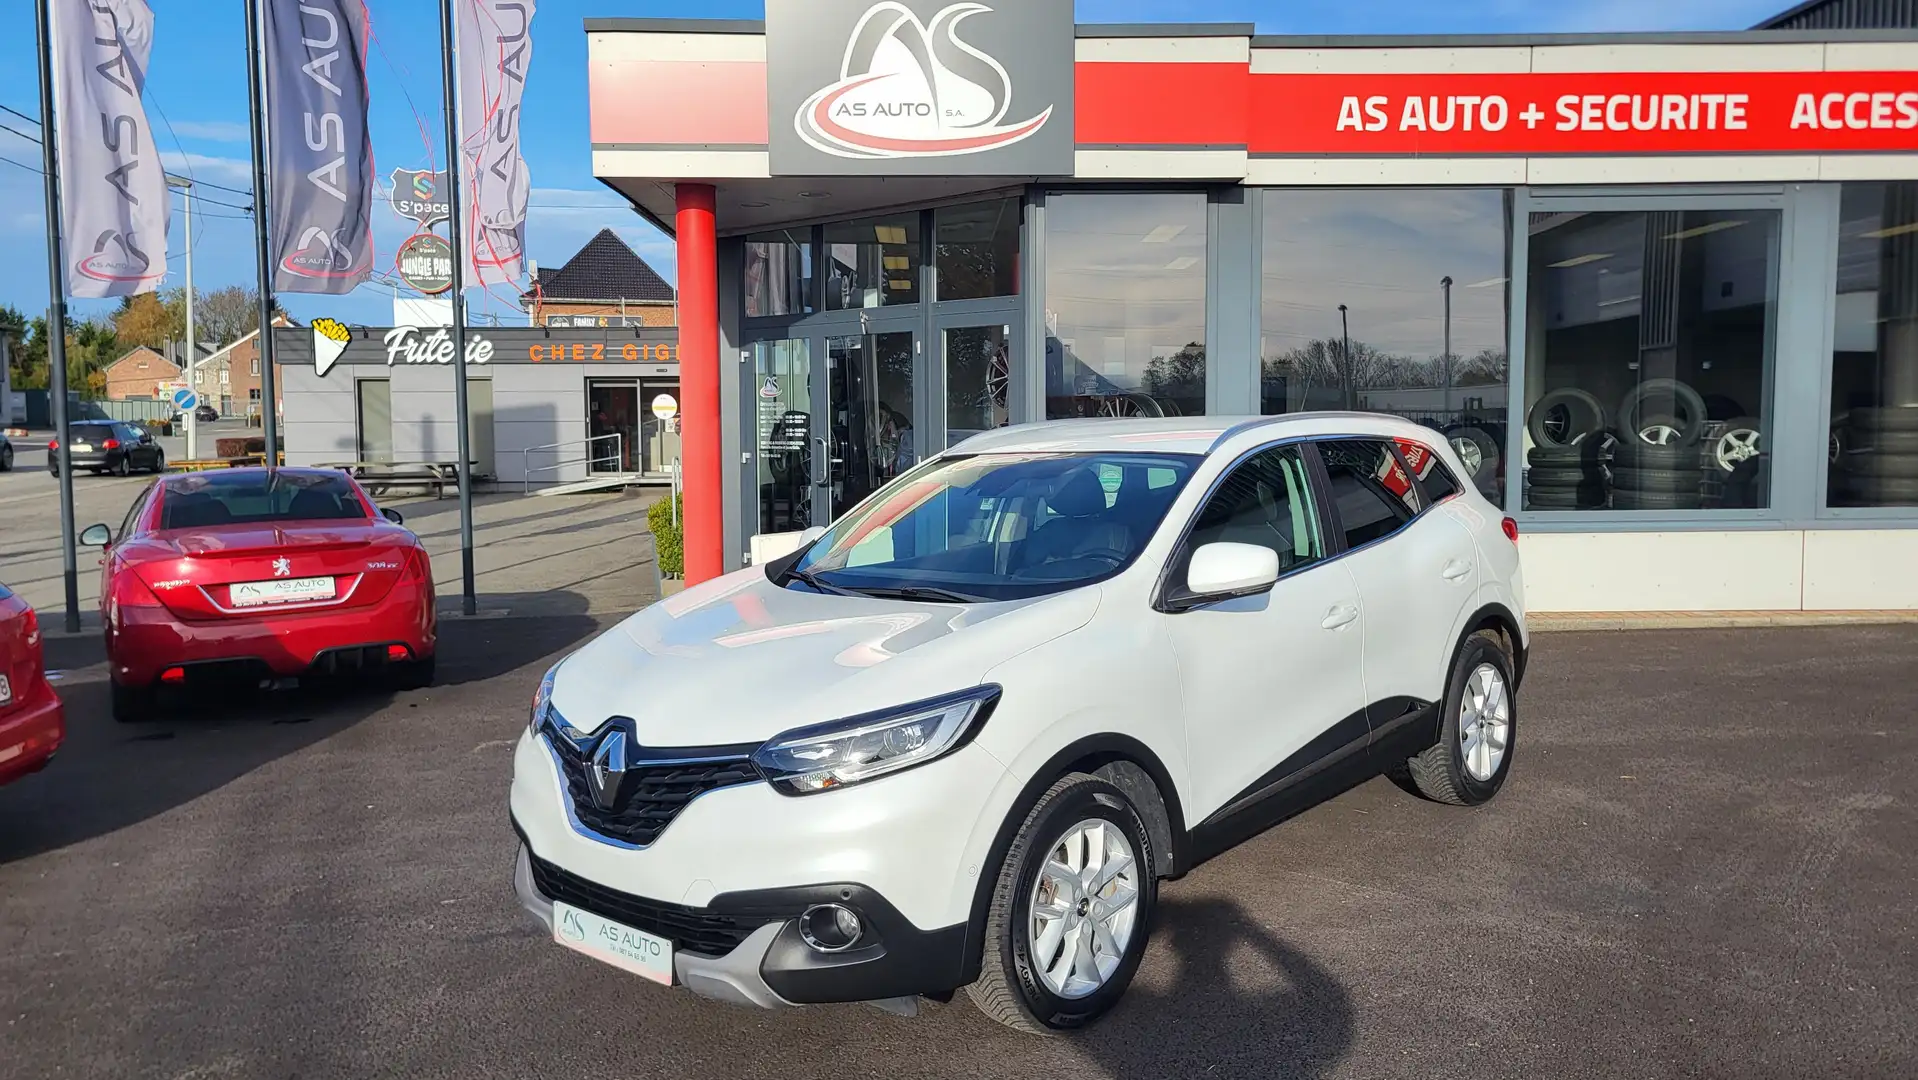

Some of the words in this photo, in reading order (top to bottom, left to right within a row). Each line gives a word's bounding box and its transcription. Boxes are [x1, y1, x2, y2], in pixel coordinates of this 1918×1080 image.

[300, 0, 341, 97] AU
[836, 103, 867, 116] AS
[873, 103, 930, 116] AUTO
[945, 109, 965, 117] S.A.
[1336, 96, 1388, 131] AS
[1399, 96, 1508, 131] AUTO
[1519, 102, 1545, 129] +
[1555, 94, 1749, 131] SECURITE
[1790, 92, 1918, 130] ACCES
[101, 112, 138, 206] AS
[304, 112, 347, 202] AS
[490, 104, 518, 182] AS
[400, 201, 450, 214] S'pace
[307, 257, 332, 265] AUTO
[400, 256, 432, 276] JUNGLE
[433, 257, 452, 276] PAR
[573, 317, 596, 328] FAMILY
[383, 324, 495, 366] Friteie
[529, 344, 604, 361] CHEZ
[274, 582, 291, 590] AS
[294, 579, 326, 589] AUTO
[598, 923, 619, 942] AS
[622, 931, 661, 956] AUTO
